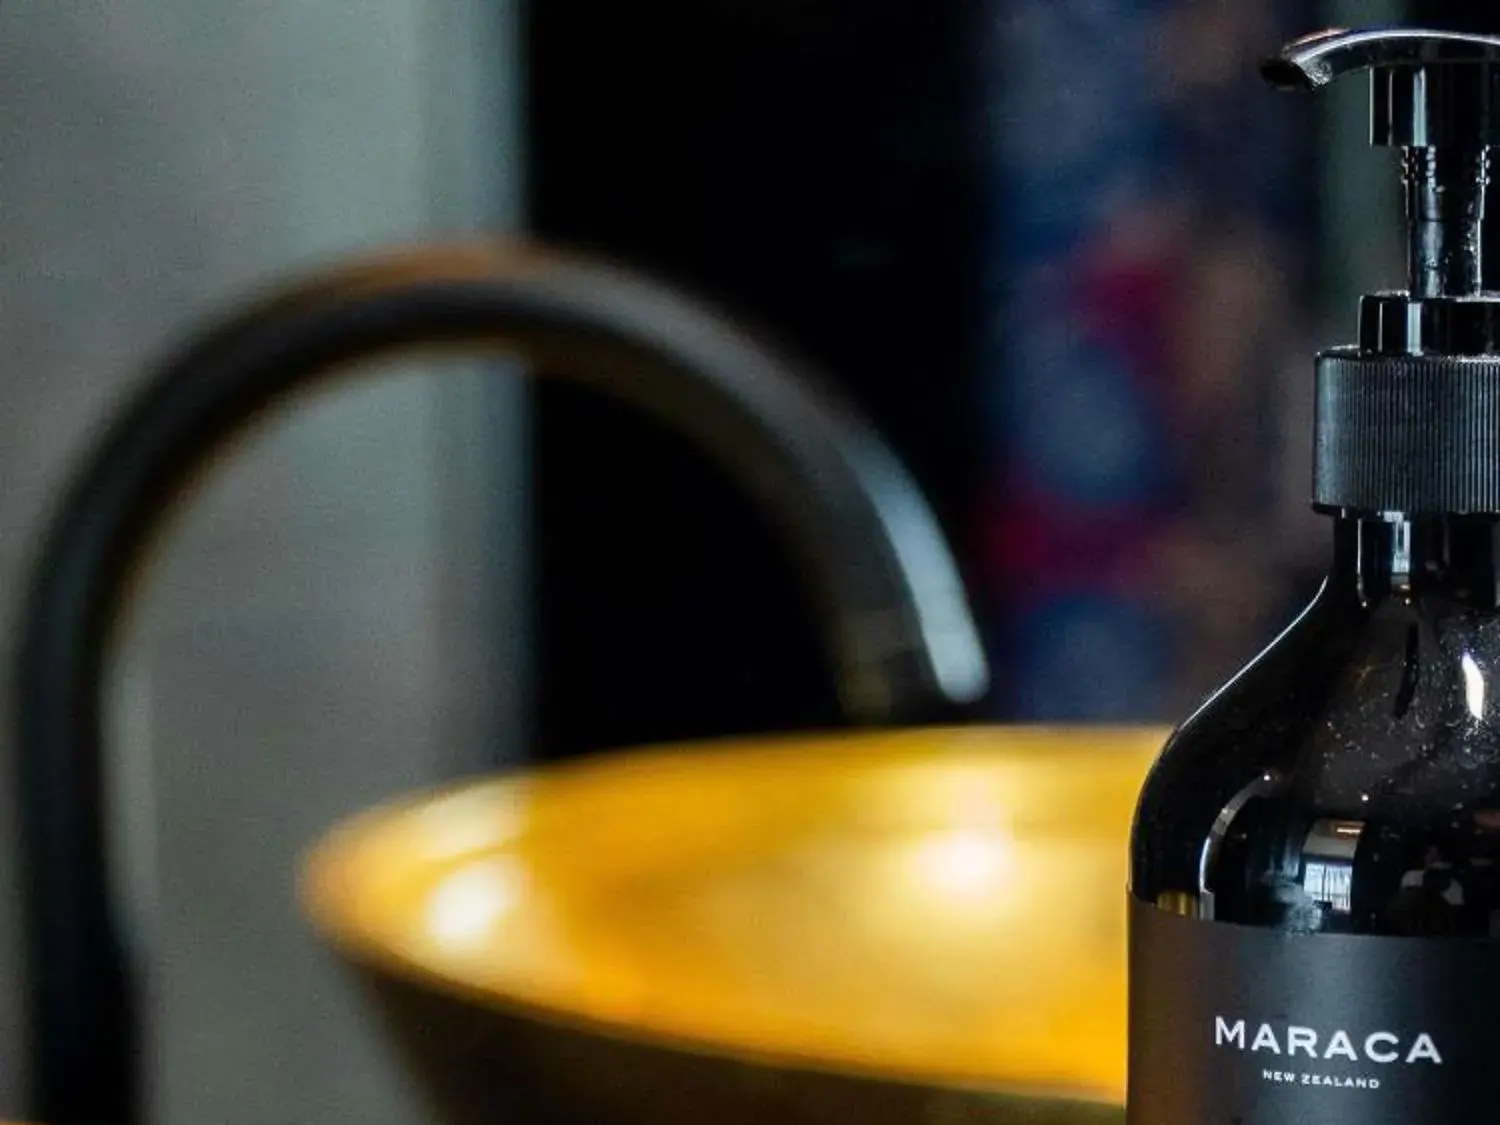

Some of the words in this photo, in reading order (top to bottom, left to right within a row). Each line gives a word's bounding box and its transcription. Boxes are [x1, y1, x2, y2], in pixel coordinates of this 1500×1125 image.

[1215, 1015, 1443, 1065] MARACA
[1262, 1069, 1296, 1083] NEW
[1301, 1073, 1381, 1089] ZEALAND
